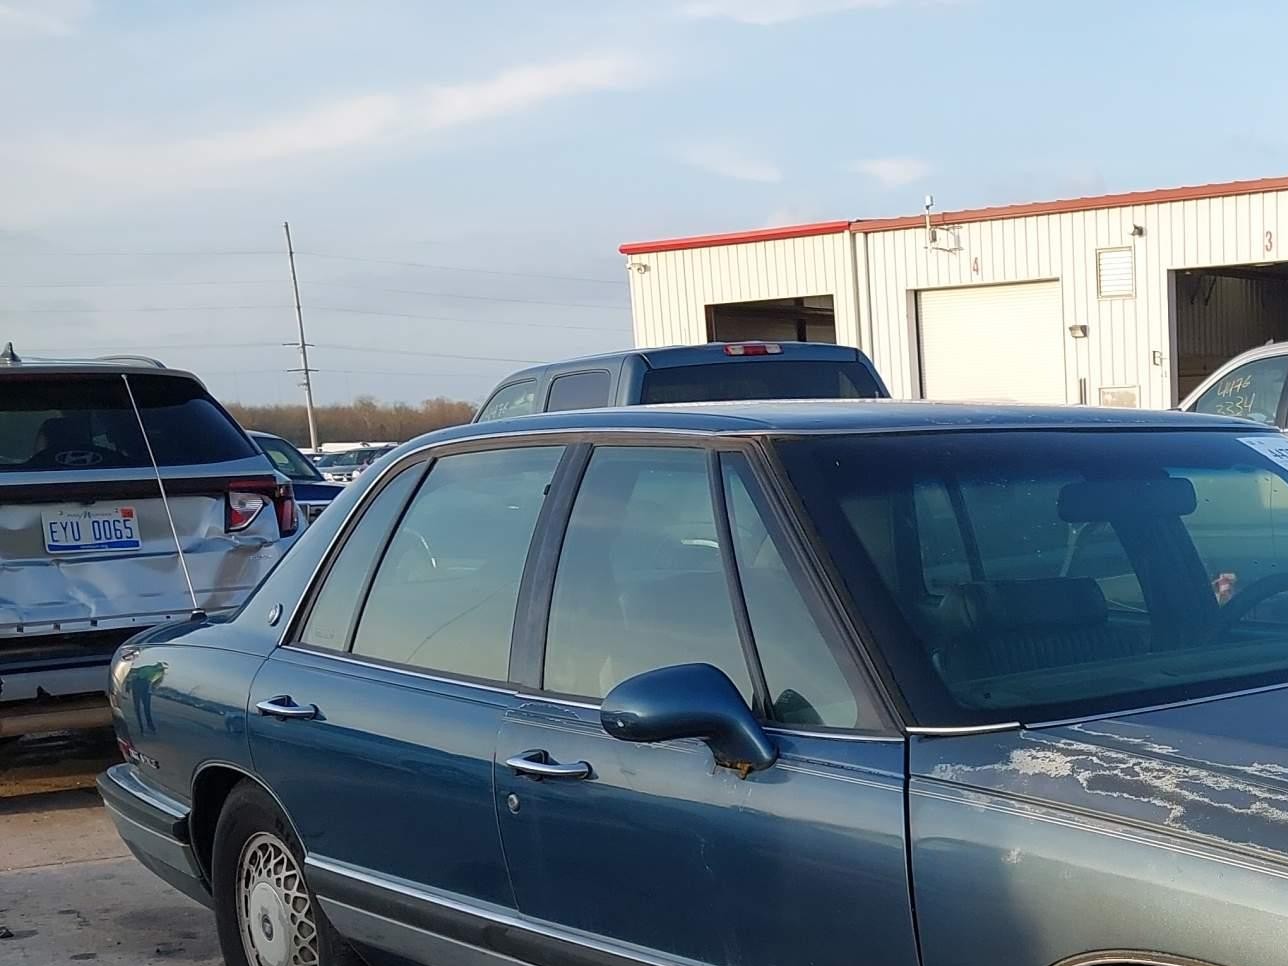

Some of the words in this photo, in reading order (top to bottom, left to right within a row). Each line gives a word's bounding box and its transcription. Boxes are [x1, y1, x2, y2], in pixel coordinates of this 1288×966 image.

[1265, 230, 1273, 252] 3
[972, 256, 979, 276] 4
[49, 521, 81, 542] EYU
[91, 519, 133, 541] 0065
